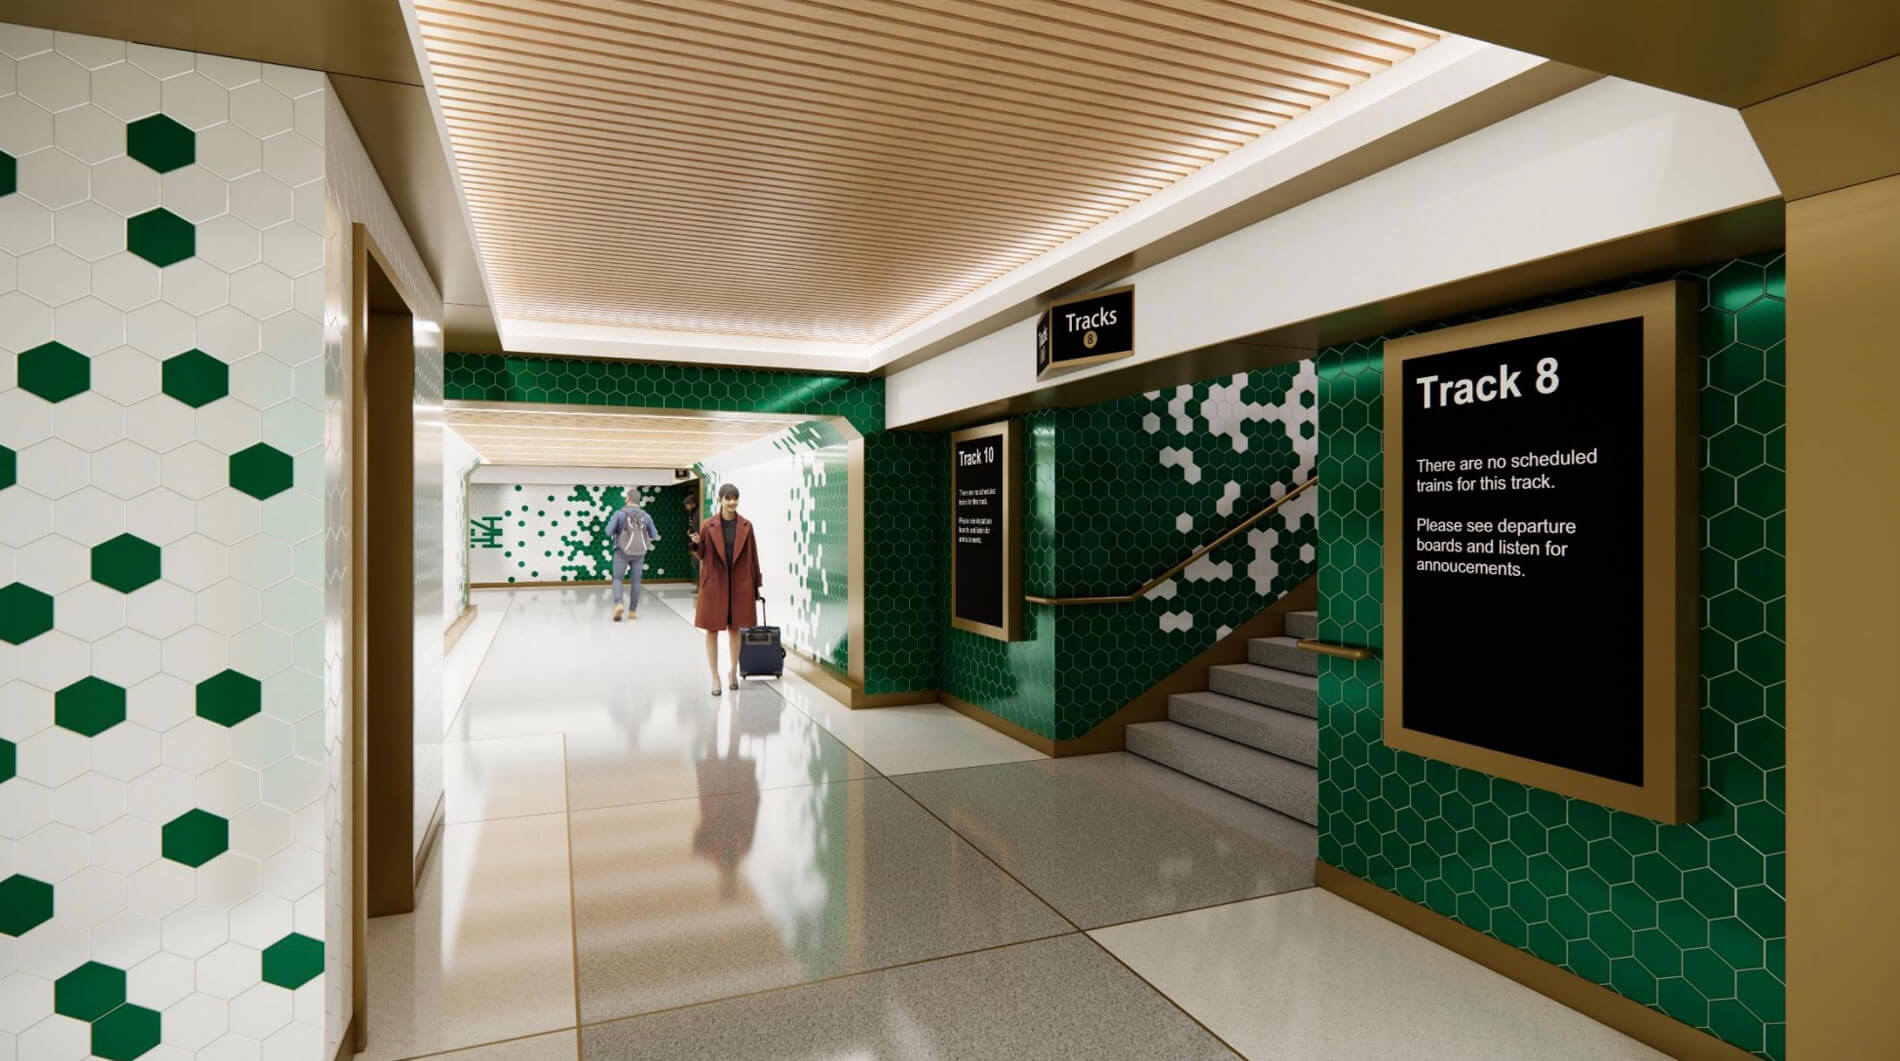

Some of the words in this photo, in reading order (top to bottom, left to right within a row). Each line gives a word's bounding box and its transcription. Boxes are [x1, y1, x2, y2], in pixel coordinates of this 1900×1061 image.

[1065, 306, 1117, 332] Tracks
[1087, 334, 1093, 345] 8
[1416, 364, 1522, 409] Track
[1535, 357, 1560, 395] 8
[958, 447, 982, 467] Track
[983, 446, 994, 463] 10
[1416, 458, 1456, 473] There
[1459, 458, 1483, 471] are
[1487, 456, 1506, 470] no
[1511, 448, 1598, 468] scheduled
[1416, 478, 1453, 493] trains
[1457, 476, 1476, 491] for
[1480, 476, 1506, 491] this
[1511, 473, 1555, 490] track.
[1416, 517, 1463, 533] Please
[1466, 521, 1493, 533] see
[1497, 518, 1577, 536] departure
[1416, 537, 1463, 553] boards
[1466, 539, 1494, 554] and
[1499, 539, 1540, 555] listen
[1545, 540, 1569, 557] for
[1416, 560, 1526, 577] annoucements.
